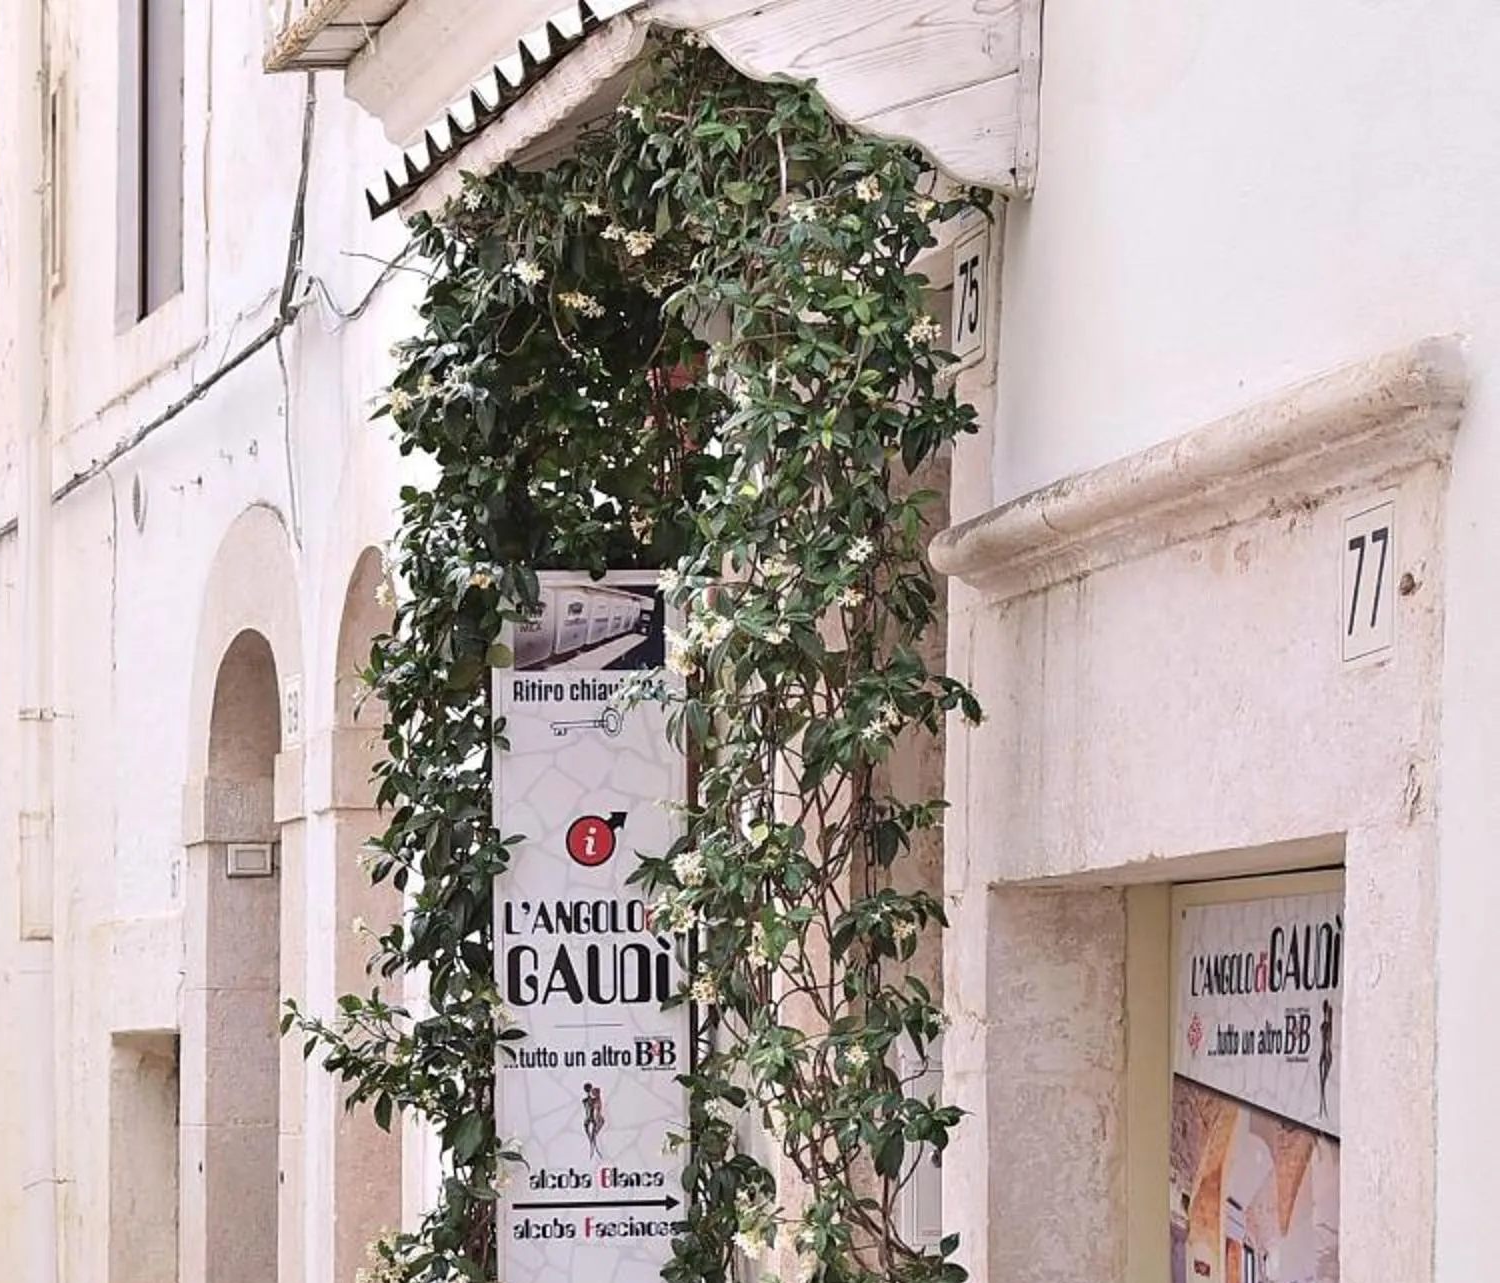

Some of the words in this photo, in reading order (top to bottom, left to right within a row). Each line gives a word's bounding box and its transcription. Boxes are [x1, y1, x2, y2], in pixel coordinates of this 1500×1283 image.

[957, 255, 980, 342] 75
[1348, 527, 1389, 636] 77
[513, 679, 565, 702] Ritiro
[570, 678, 624, 702] chiav
[505, 900, 645, 935] L'ANGOLO
[564, 1051, 586, 1067] un
[592, 1044, 632, 1068] altro
[529, 1167, 592, 1190] alcoba
[513, 1217, 577, 1240] alcoba
